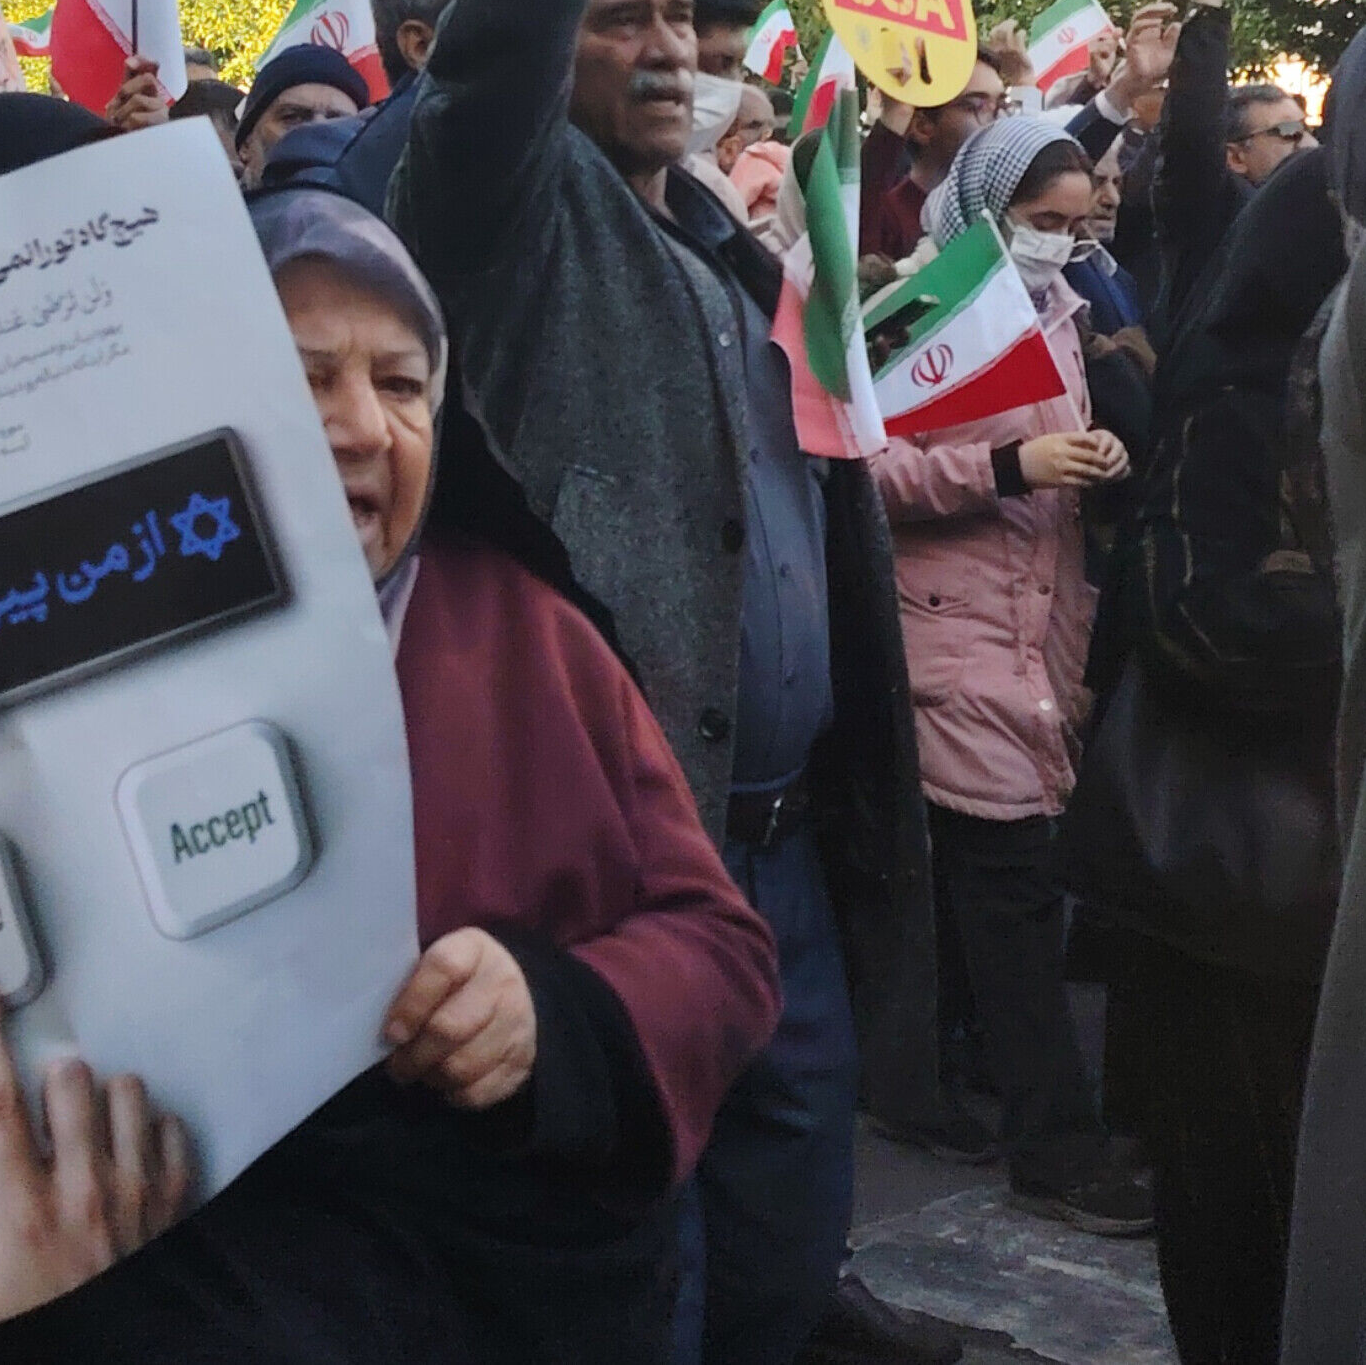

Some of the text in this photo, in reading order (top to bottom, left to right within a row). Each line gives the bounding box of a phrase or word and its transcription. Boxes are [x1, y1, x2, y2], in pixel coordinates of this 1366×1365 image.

[57, 543, 130, 605] من
[133, 510, 165, 583] از
[169, 789, 276, 865] Accept
